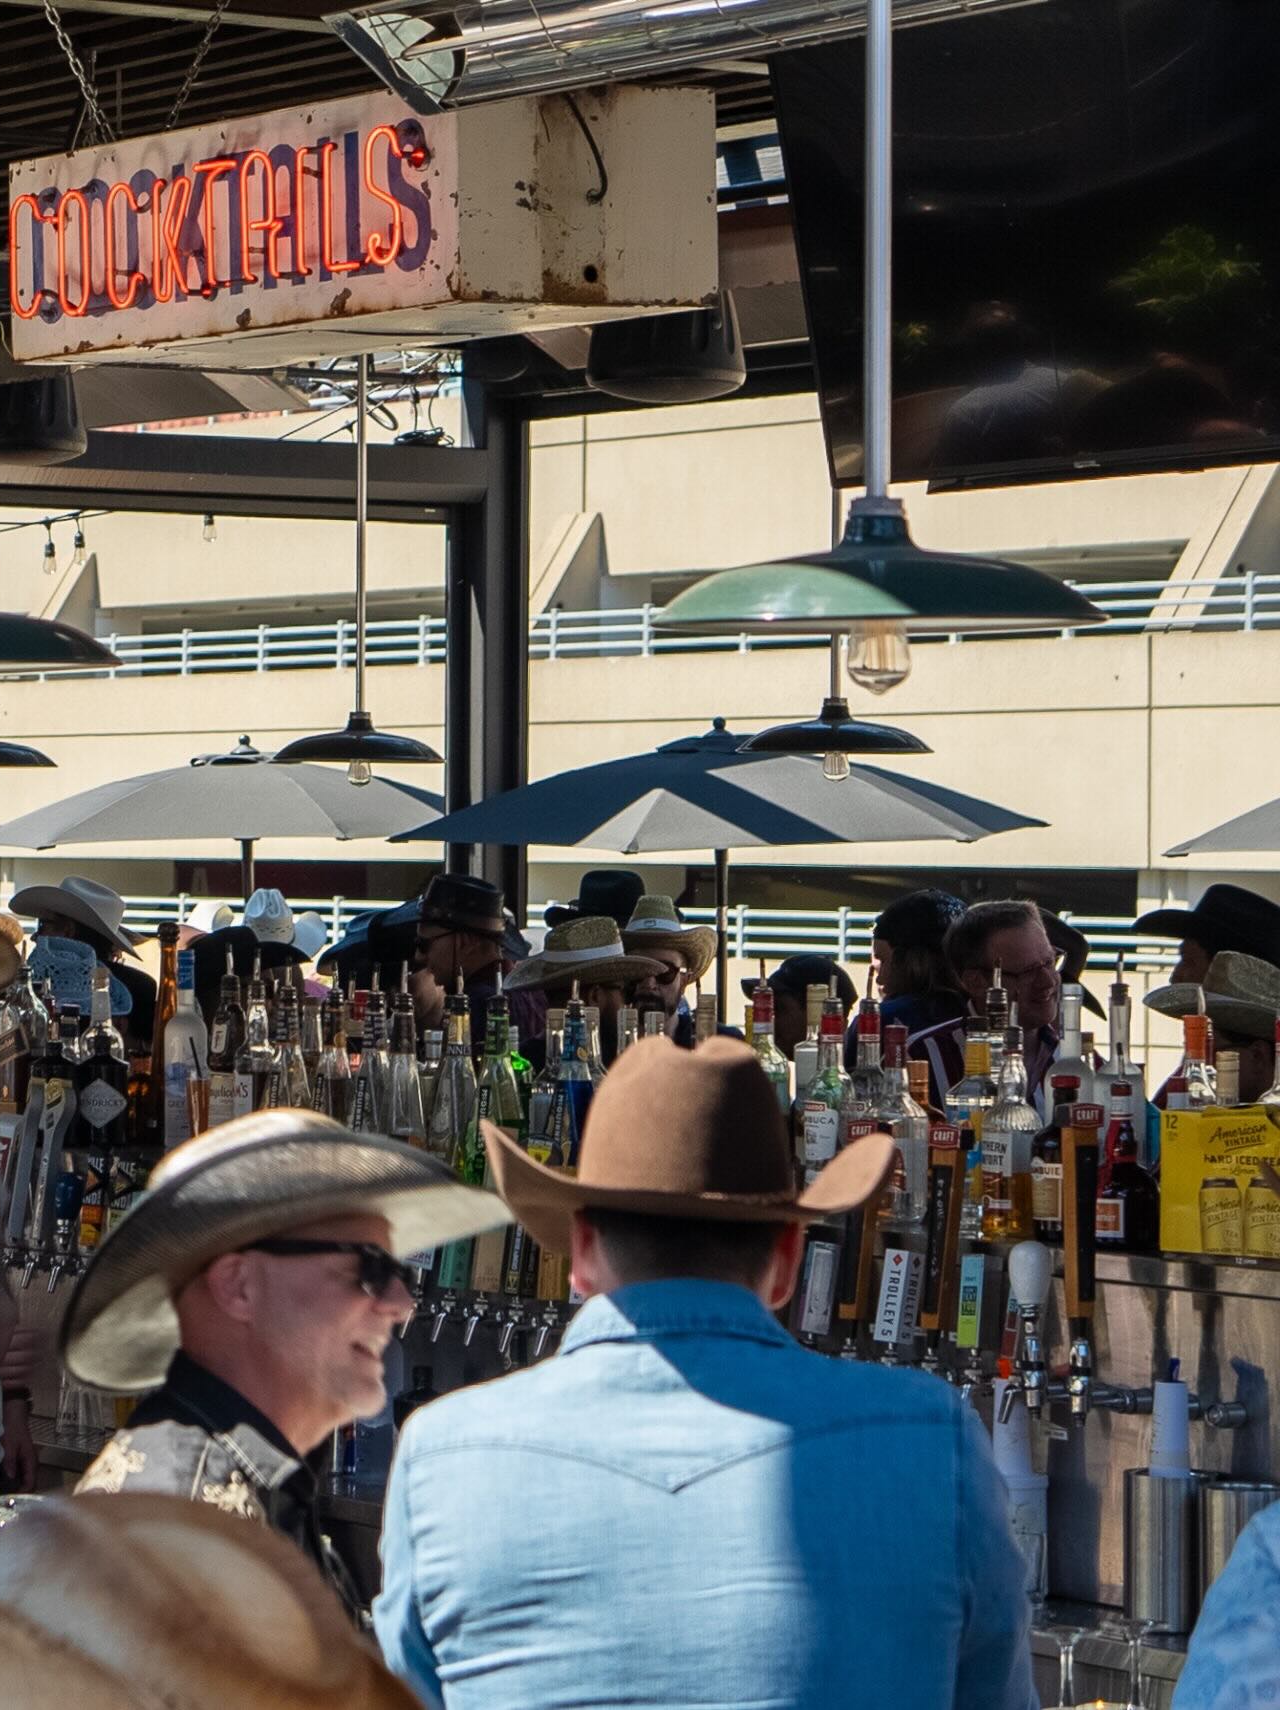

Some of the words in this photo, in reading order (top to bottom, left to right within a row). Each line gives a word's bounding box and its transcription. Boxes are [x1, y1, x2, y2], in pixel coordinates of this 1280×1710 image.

[9, 117, 433, 324] COCKTAILS
[1076, 1109, 1099, 1121] CRAFT
[1165, 1115, 1178, 1129] 12
[851, 1125, 872, 1136] CRAFT
[933, 1131, 955, 1142] CRAFT
[1224, 1134, 1262, 1147] VINTAGE
[1204, 1154, 1232, 1164] HARD
[1235, 1155, 1260, 1166] ICED
[883, 1269, 901, 1325] TROLLEY
